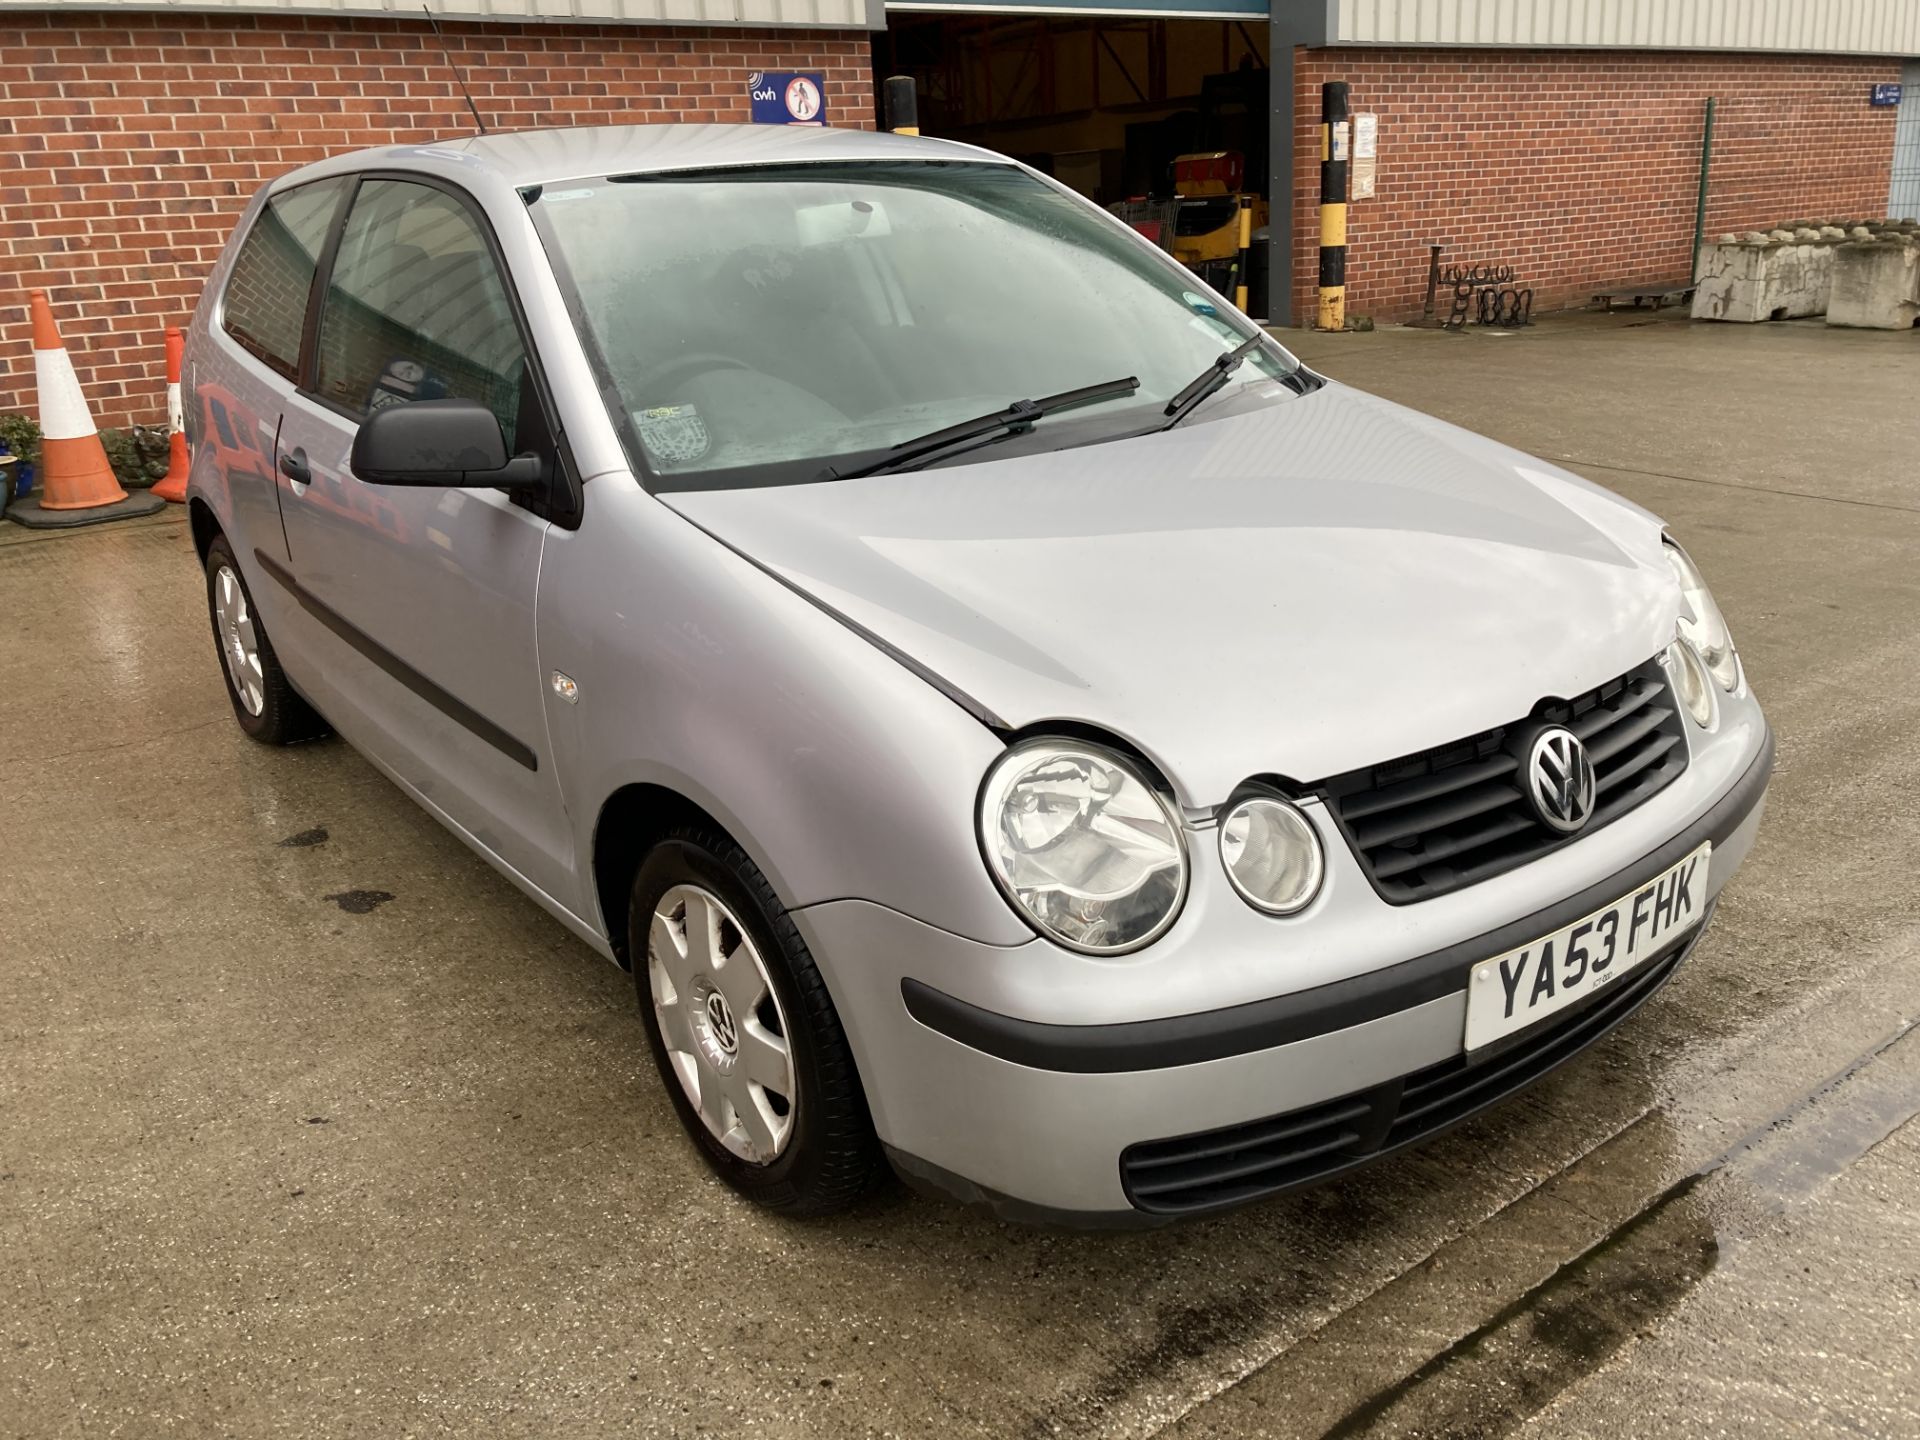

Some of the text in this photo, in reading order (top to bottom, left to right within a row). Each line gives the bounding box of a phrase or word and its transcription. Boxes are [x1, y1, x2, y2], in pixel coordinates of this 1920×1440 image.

[753, 86, 777, 101] cwh
[1499, 855, 1698, 1019] YA53 FHK
